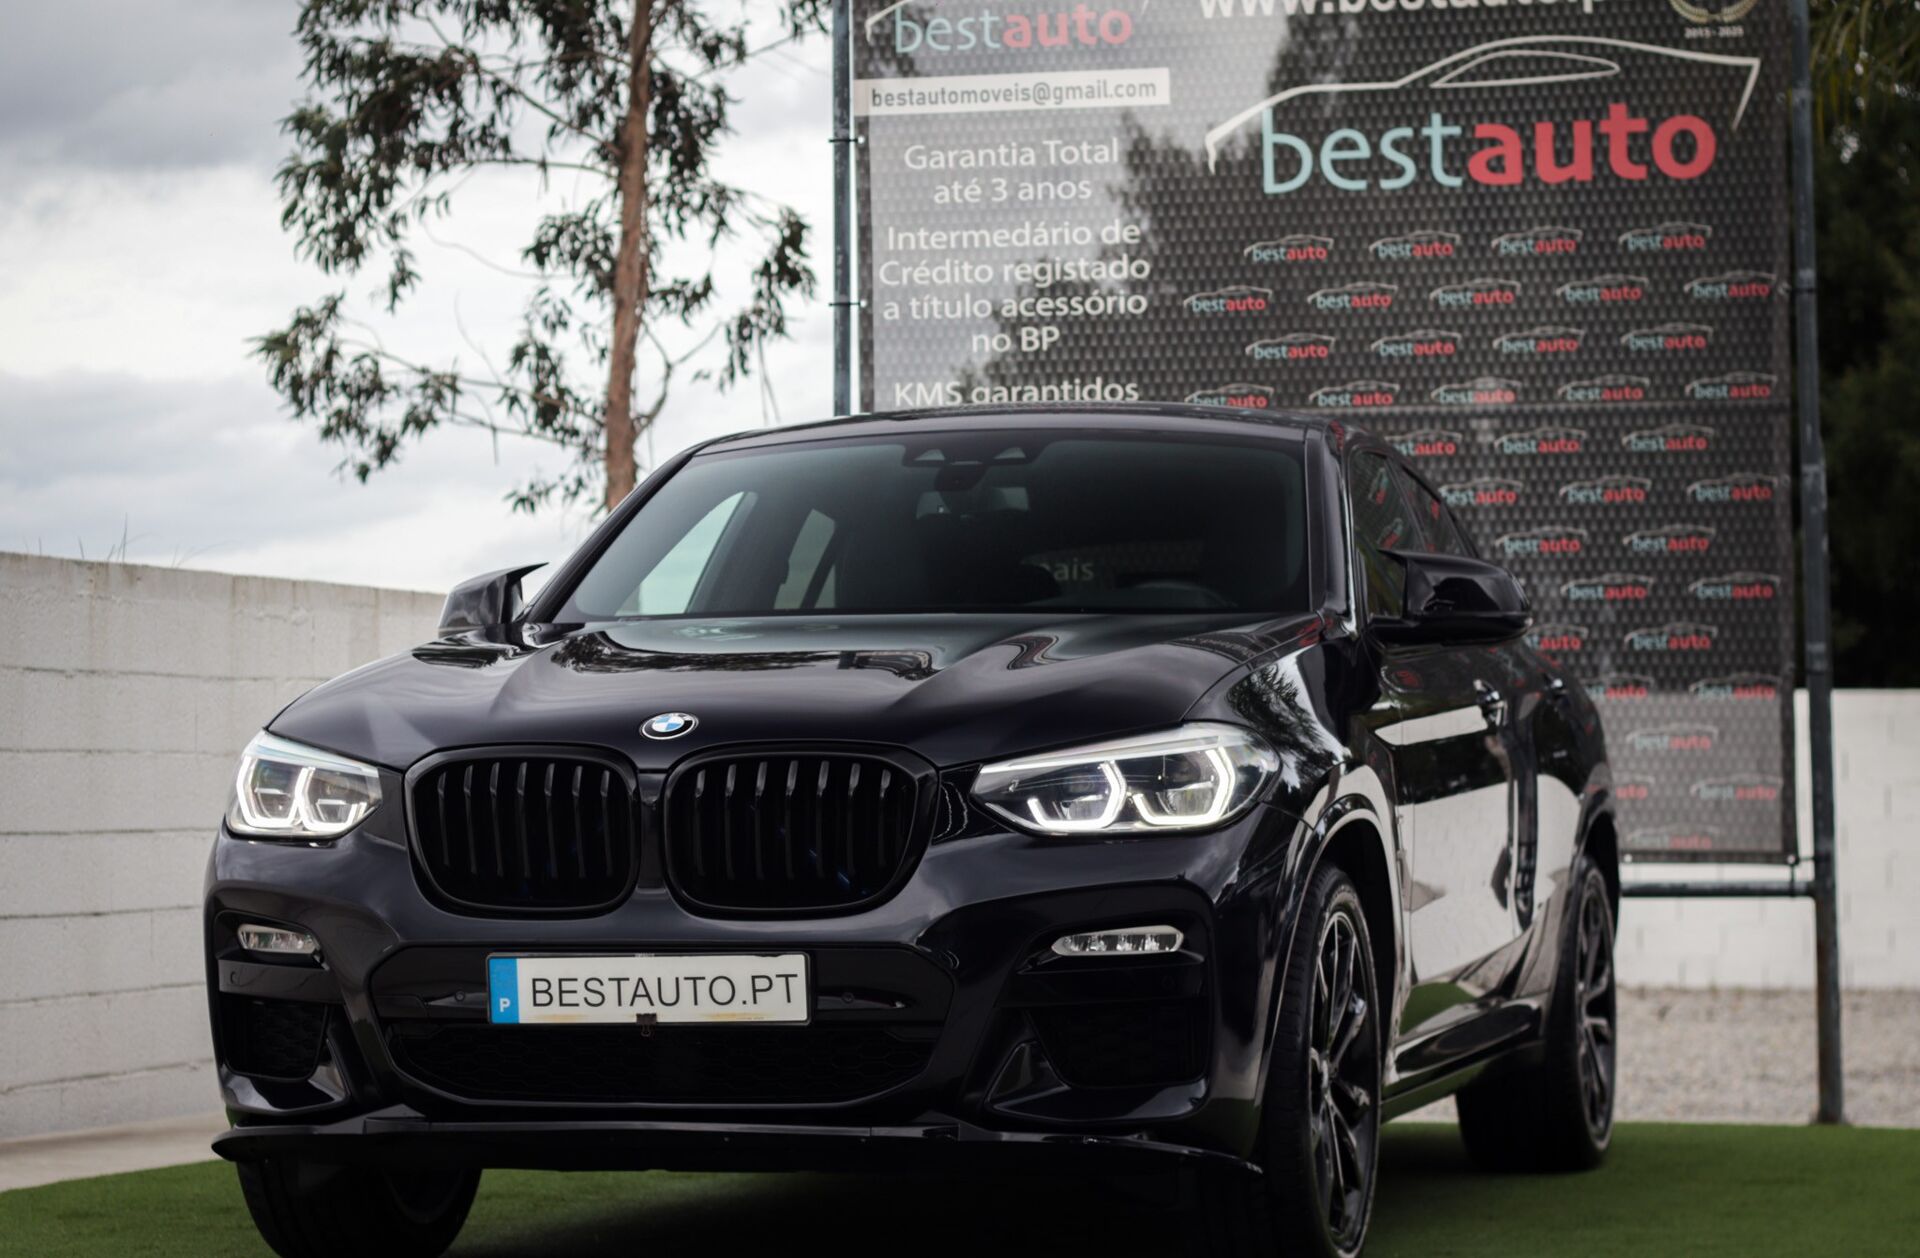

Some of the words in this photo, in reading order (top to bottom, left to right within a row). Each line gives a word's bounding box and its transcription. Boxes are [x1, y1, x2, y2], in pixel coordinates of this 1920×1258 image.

[895, 4, 1133, 53] bestauto
[872, 80, 1157, 107] bestautomoveis@gmail.com
[904, 141, 1036, 170] Garantia
[1043, 138, 1119, 165] Total
[1261, 103, 1717, 195] bestauto
[934, 179, 982, 204] até
[991, 179, 1008, 202] 3
[1018, 179, 1092, 201] anos
[888, 221, 1092, 250] Intermedário
[1101, 219, 1141, 244] de
[1628, 233, 1705, 250] bestauto
[1251, 243, 1328, 262] bestauto
[1377, 240, 1454, 257] bestauto
[1500, 237, 1577, 255] bestauto
[878, 257, 993, 286] Crédito
[1003, 254, 1150, 289] registado
[1437, 288, 1515, 305] bestauto
[1565, 285, 1642, 302] bestauto
[1693, 281, 1770, 298] bestauto
[883, 301, 900, 320] a
[910, 293, 993, 319] título
[1001, 289, 1148, 318] acessório
[1191, 294, 1268, 313] bestauto
[1316, 291, 1392, 310] bestauto
[971, 331, 1012, 353] no
[1020, 326, 1060, 351] BP
[1378, 339, 1456, 357] bestauto
[1501, 336, 1579, 353] bestauto
[1629, 334, 1707, 351] bestauto
[1253, 343, 1329, 361] bestauto
[895, 381, 962, 407] KMS
[971, 377, 1139, 403] garantidos
[1317, 389, 1393, 408] bestauto
[1439, 388, 1516, 405] bestauto
[1566, 384, 1644, 402] bestauto
[1695, 383, 1770, 400] bestauto
[1394, 440, 1456, 457] stauto
[1502, 437, 1580, 455] bestauto
[1631, 433, 1708, 452] bestauto
[1568, 485, 1646, 504] bestauto
[1697, 484, 1772, 501] bestauto
[1504, 537, 1581, 554] bestauto
[1632, 535, 1709, 552] bestauto
[1570, 584, 1648, 602] bestauto
[1697, 582, 1774, 600] bestauto
[531, 973, 798, 1007] BESTAUTO.PT
[500, 998, 511, 1012] P
